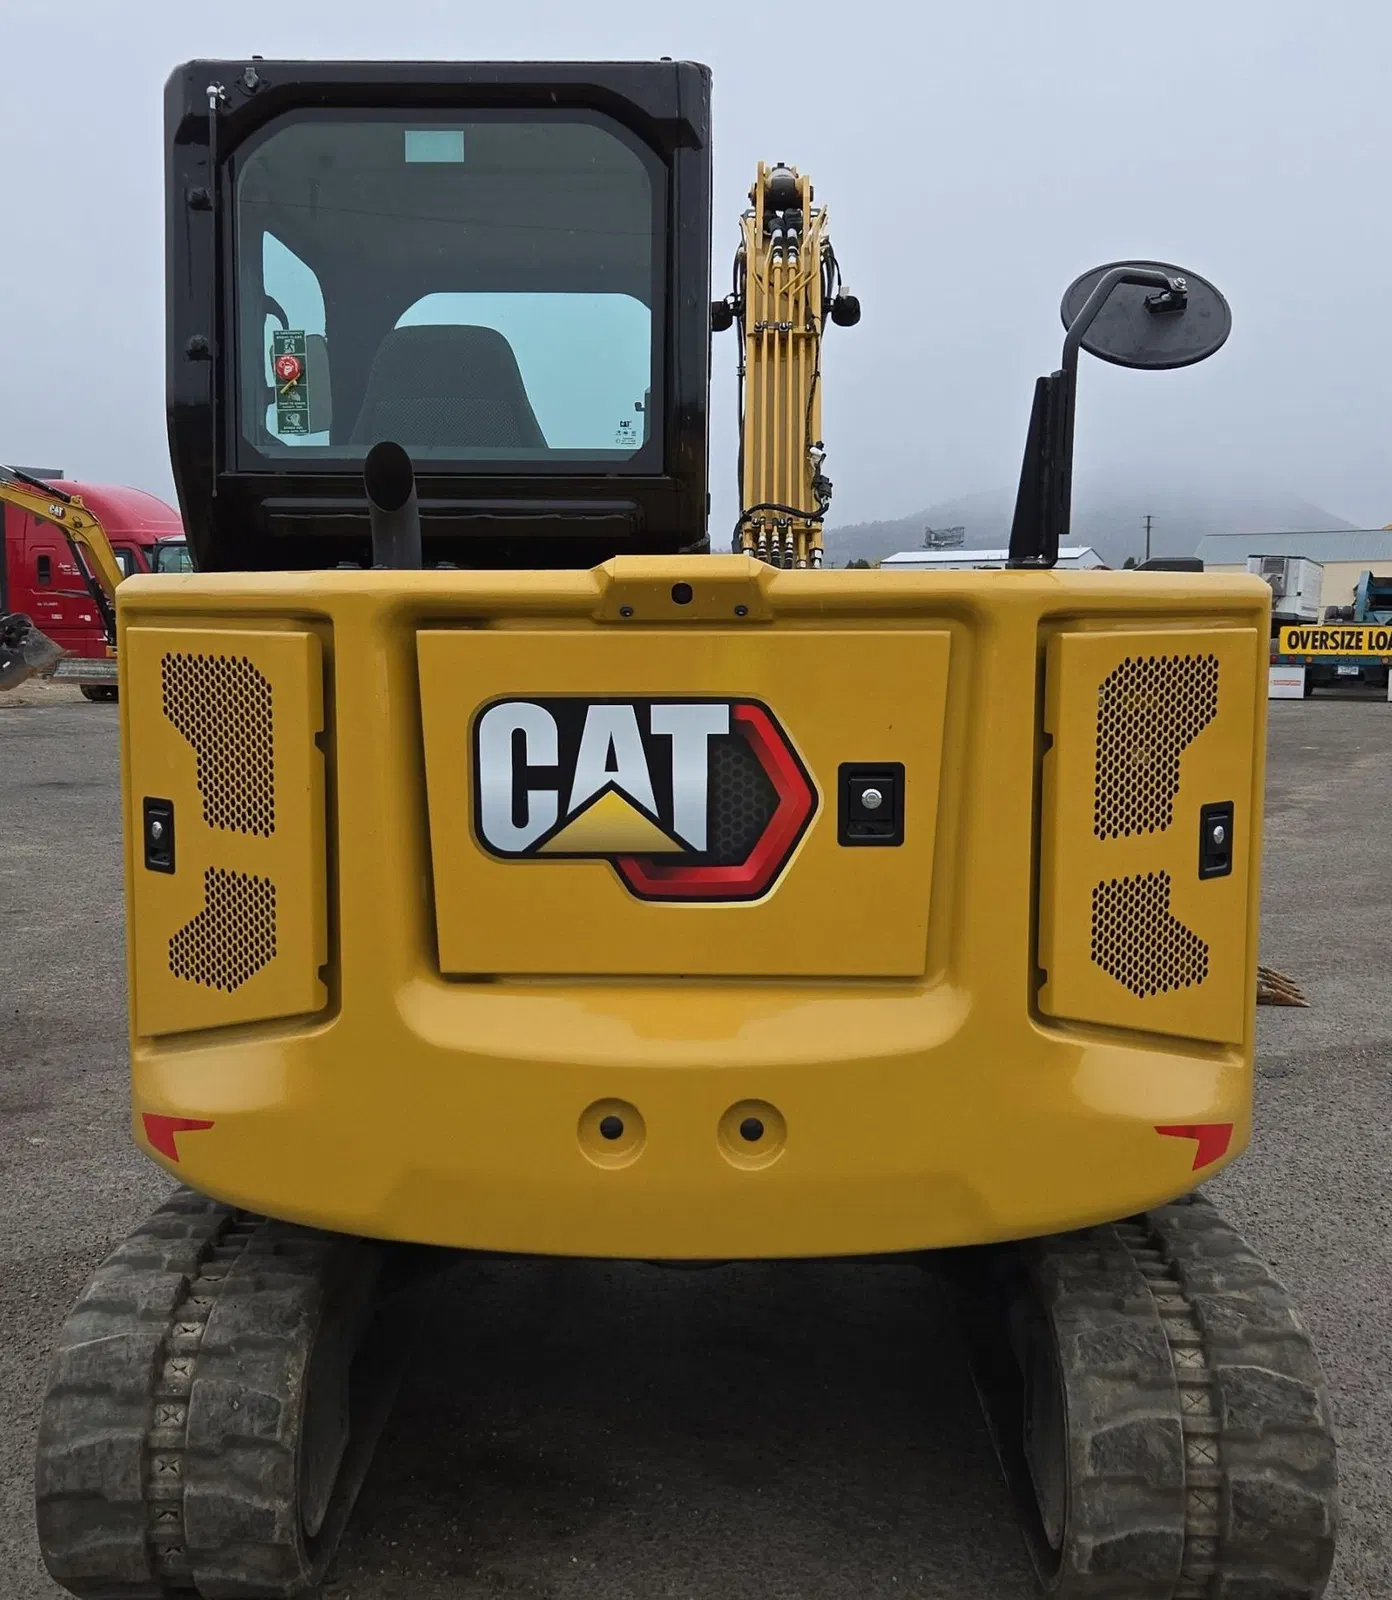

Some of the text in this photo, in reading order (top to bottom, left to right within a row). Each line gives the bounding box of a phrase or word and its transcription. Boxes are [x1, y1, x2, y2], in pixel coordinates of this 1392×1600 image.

[49, 504, 64, 517] CAT
[1287, 630, 1363, 650] OVERSIZE
[479, 702, 730, 852] CAT
